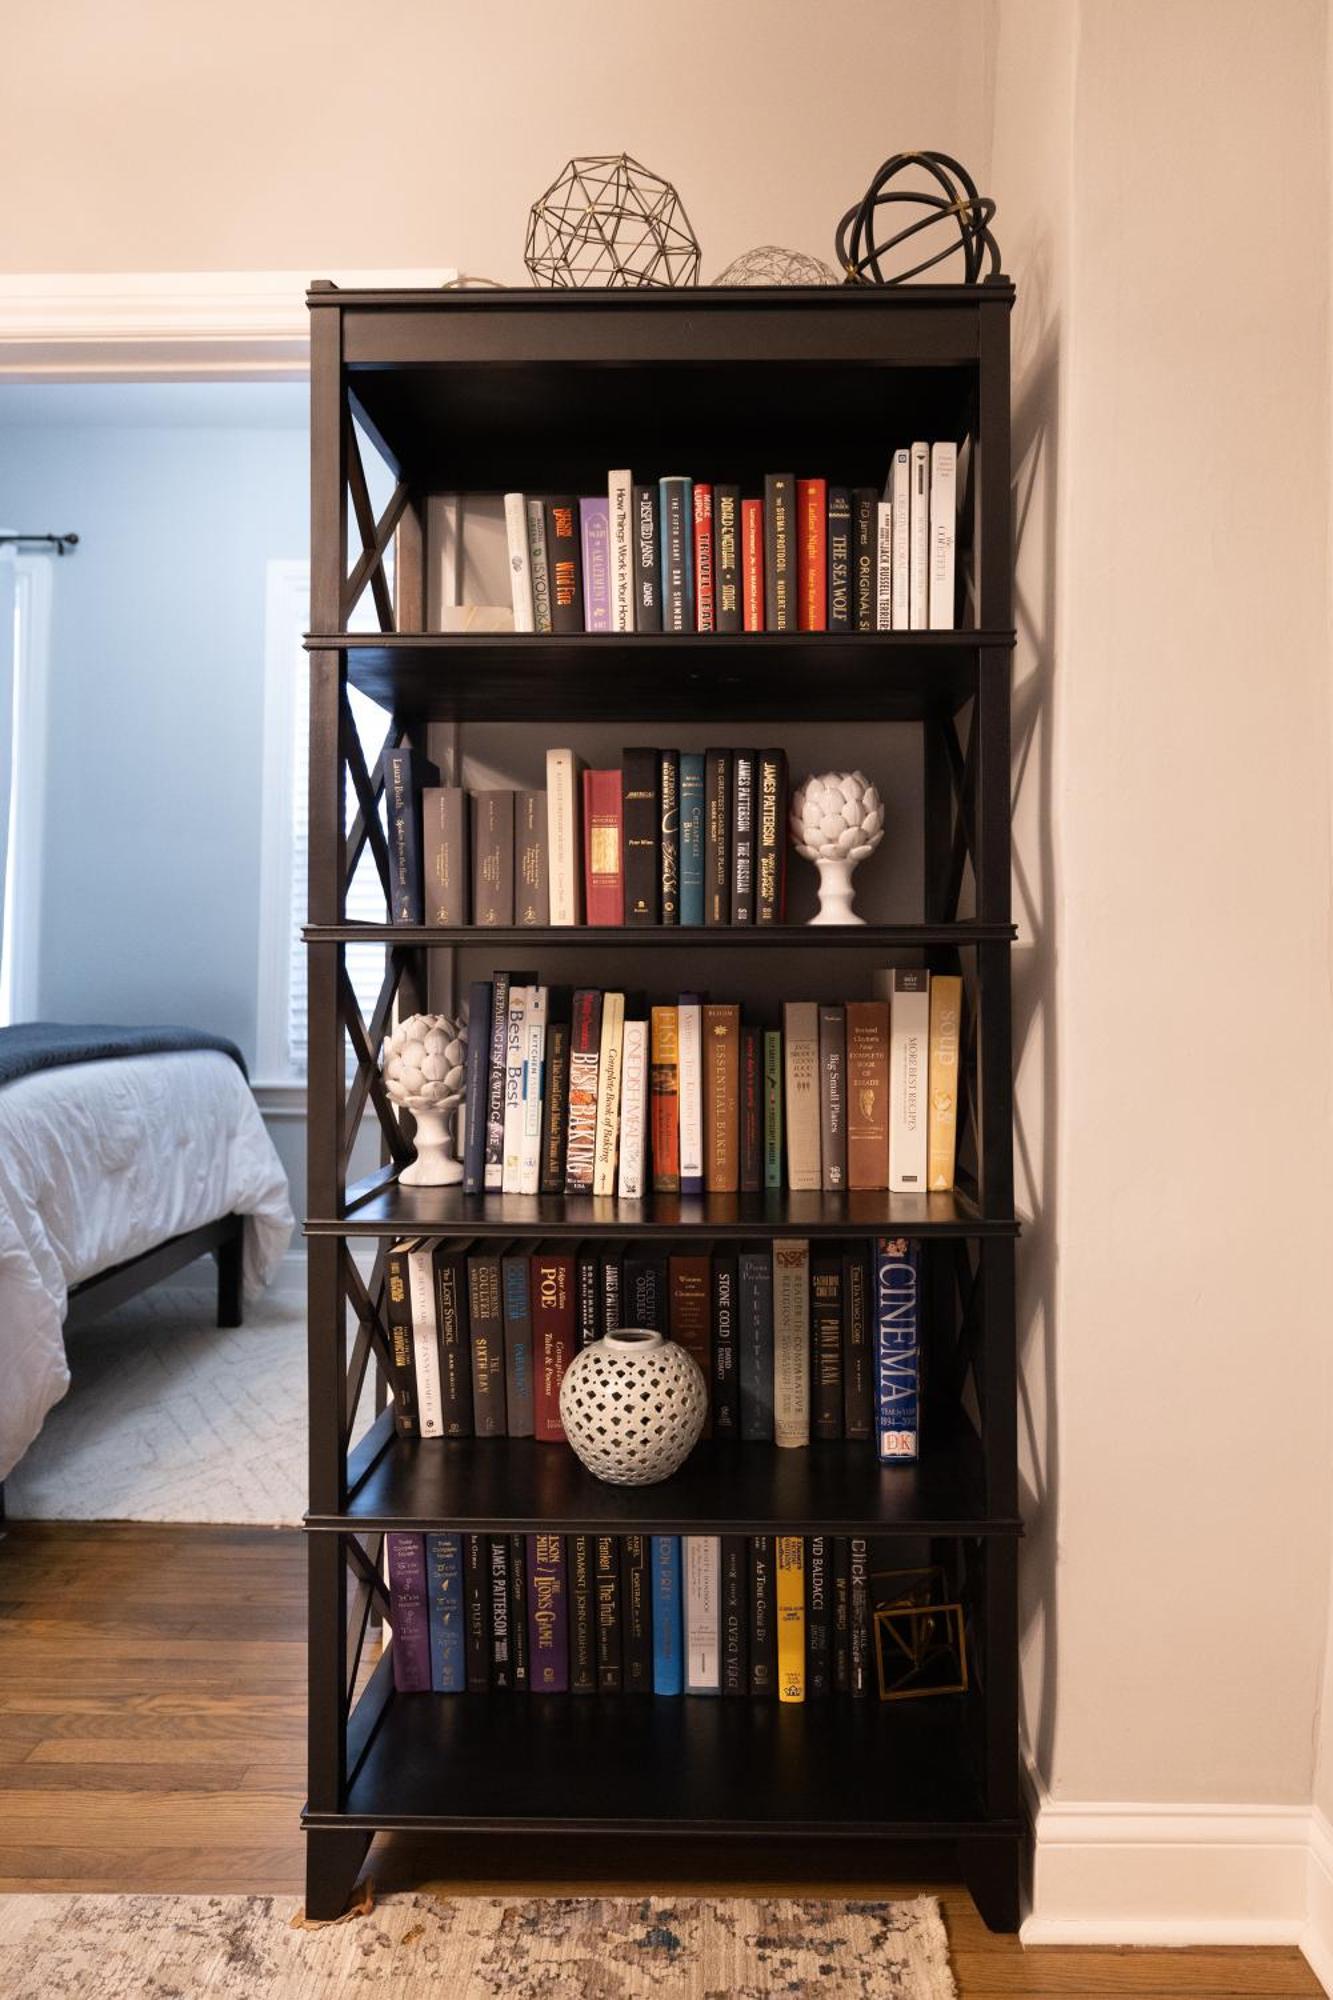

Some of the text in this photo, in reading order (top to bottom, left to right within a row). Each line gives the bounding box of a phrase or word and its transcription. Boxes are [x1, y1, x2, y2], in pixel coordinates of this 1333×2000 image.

[616, 488, 626, 511] How
[694, 489, 703, 523] LUPICA
[703, 494, 711, 518] MIKE
[615, 512, 627, 543] Things
[640, 501, 653, 567] DISPUTED LANDS
[721, 497, 735, 570] DONALD WESTLAKE
[776, 507, 785, 572] SIGMA PROTOCOL
[808, 535, 817, 559] Night
[859, 520, 869, 545] James
[618, 545, 627, 570] Work
[699, 533, 711, 588] TRAVEL
[880, 546, 889, 564] JACK
[555, 561, 575, 606] Wild Fire
[618, 582, 627, 603] Your
[619, 573, 627, 581] in
[643, 582, 653, 607] ADAMS
[722, 585, 735, 611] SMOKE
[777, 580, 785, 608] ROBERT
[833, 535, 847, 621] THE SEA WOLF
[859, 556, 870, 617] ORIGINAL
[880, 566, 889, 596] RUSSELL
[673, 570, 681, 630] DAN SIMMONS
[393, 758, 405, 809] Laura Bush
[717, 776, 725, 813] GREATEST
[737, 759, 751, 832] JAMES PATTERSON
[762, 762, 776, 846] JAMES PATTERSON
[737, 842, 749, 893] THE RUSSIAN
[493, 982, 506, 1042] PREPARING
[509, 1010, 524, 1051] Best
[659, 1012, 675, 1058] FISH
[492, 1044, 503, 1070] FISH
[553, 1059, 563, 1075] The
[570, 1052, 599, 1095] BEST
[606, 1049, 617, 1092] Complete
[491, 1081, 502, 1110] WILD
[507, 1066, 521, 1109] Best
[551, 1076, 562, 1093] Lord
[551, 1094, 561, 1113] God
[604, 1092, 614, 1114] Book
[716, 1044, 727, 1166] ESSENTIAL BAKER
[828, 1054, 839, 1133] Big Small Plates
[908, 1037, 918, 1131] MORE BEST RECIPES
[490, 1111, 500, 1145] GAME
[567, 1103, 596, 1174] BAKING
[602, 1117, 613, 1129] of
[550, 1135, 560, 1157] Them
[550, 1159, 559, 1172] All
[600, 1129, 613, 1163] Baking
[479, 1267, 489, 1319] COULTER
[490, 1266, 498, 1319] CATHERINE
[541, 1268, 556, 1308] POE
[558, 1267, 566, 1288] Edgar
[605, 1264, 618, 1291] JAMES
[645, 1270, 656, 1328] EXECUTIVE
[443, 1282, 454, 1345] LOST SYMBOL
[636, 1277, 646, 1322] ORDERS
[719, 1273, 730, 1338] STONE COLD
[782, 1276, 792, 1326] RELIGION
[794, 1276, 802, 1413] READER IN COMPARATIVE
[820, 1319, 840, 1349] POINT
[853, 1323, 862, 1344] CODE
[879, 1263, 918, 1404] CINEMA
[476, 1338, 488, 1394] SIXTH DAY
[544, 1332, 553, 1396] Tales & Poems
[886, 1435, 911, 1450] DK
[492, 1544, 506, 1576] JAMES
[577, 1536, 587, 1588] TESTAMENT
[599, 1537, 613, 1571] Franken
[851, 1539, 867, 1586] Click
[600, 1582, 616, 1627] The Truth
[756, 1576, 765, 1598] TIME
[812, 1559, 823, 1610] BALDACCI
[472, 1603, 481, 1637] DUST
[492, 1579, 508, 1636] PATTERSON
[533, 1576, 556, 1649] LION'S GAME
[577, 1595, 587, 1665] JOHN GRISHAM
[728, 1616, 738, 1652] DEAD
